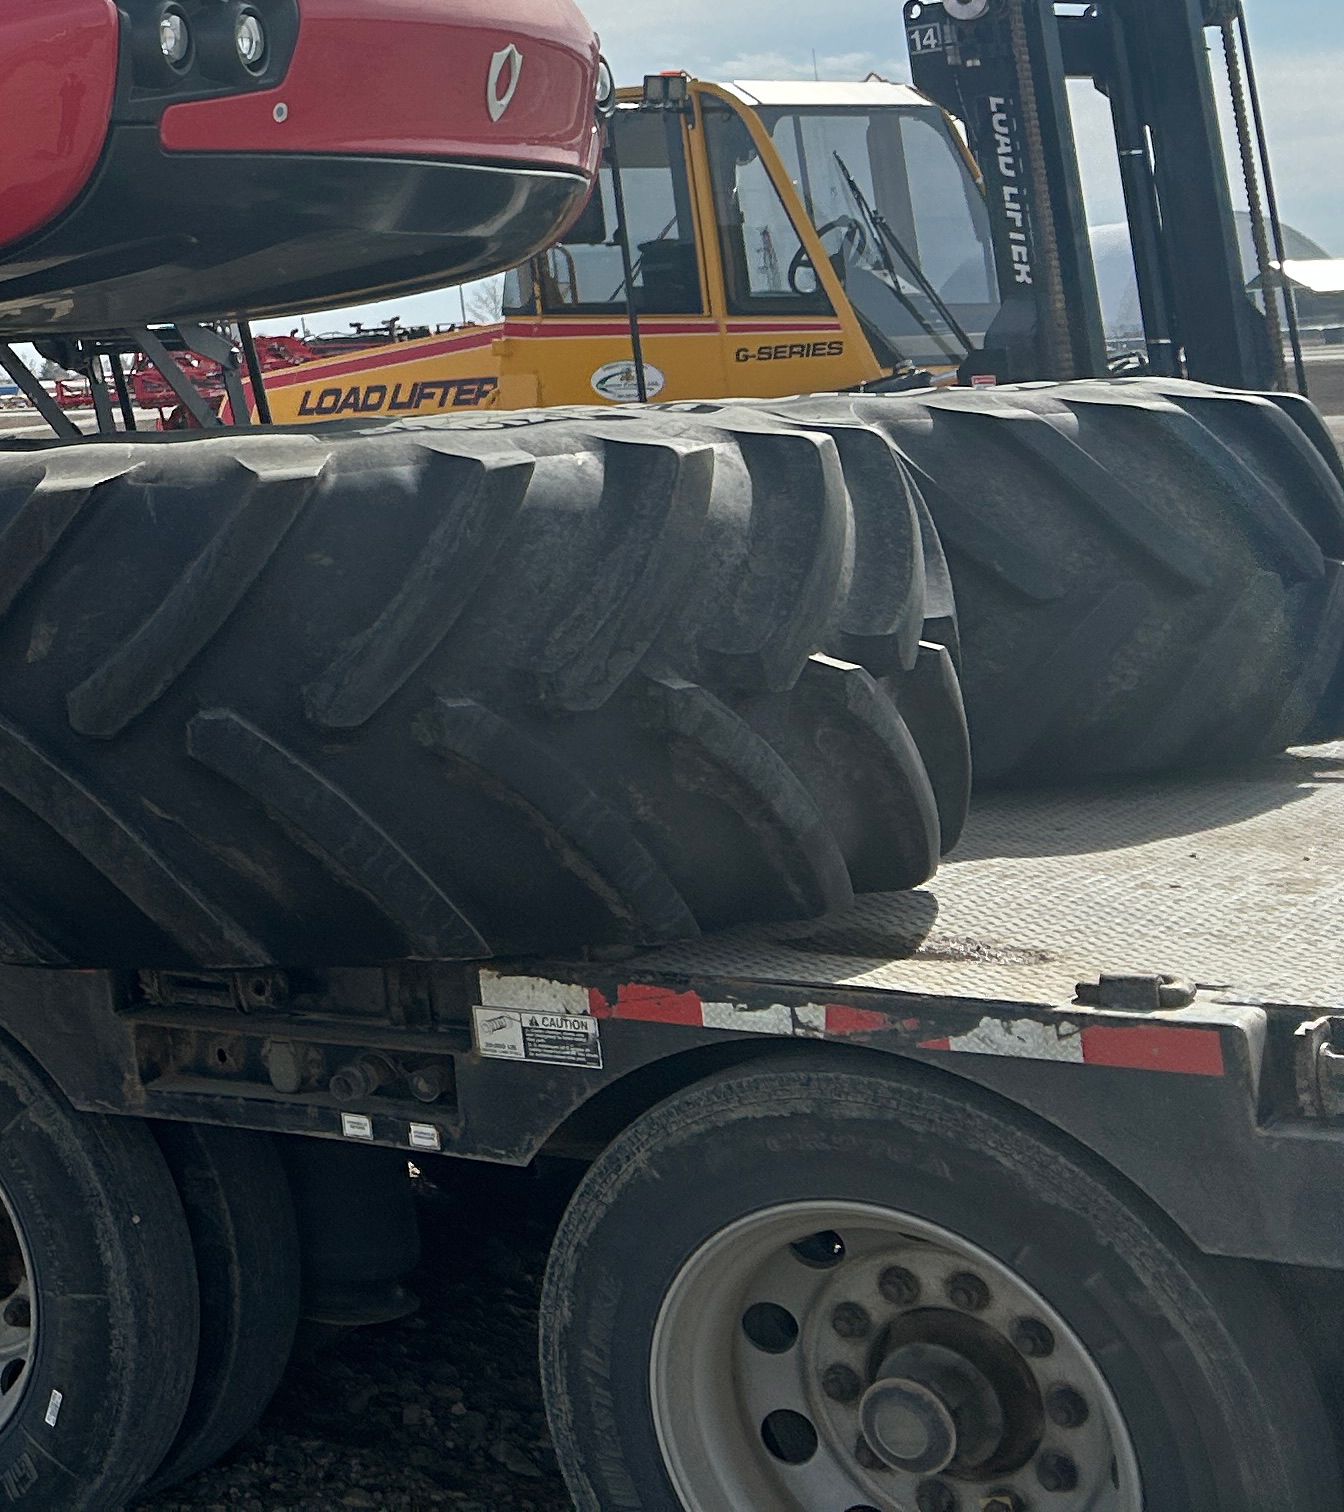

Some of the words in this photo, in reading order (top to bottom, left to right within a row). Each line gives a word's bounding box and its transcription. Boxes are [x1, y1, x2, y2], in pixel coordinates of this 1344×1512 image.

[910, 28, 938, 51] 14
[987, 94, 1023, 179] LOAD
[1001, 184, 1034, 286] LIFTER
[735, 340, 844, 362] G-SERIES
[297, 385, 388, 416] LOAD
[541, 1015, 590, 1032] CAUTION
